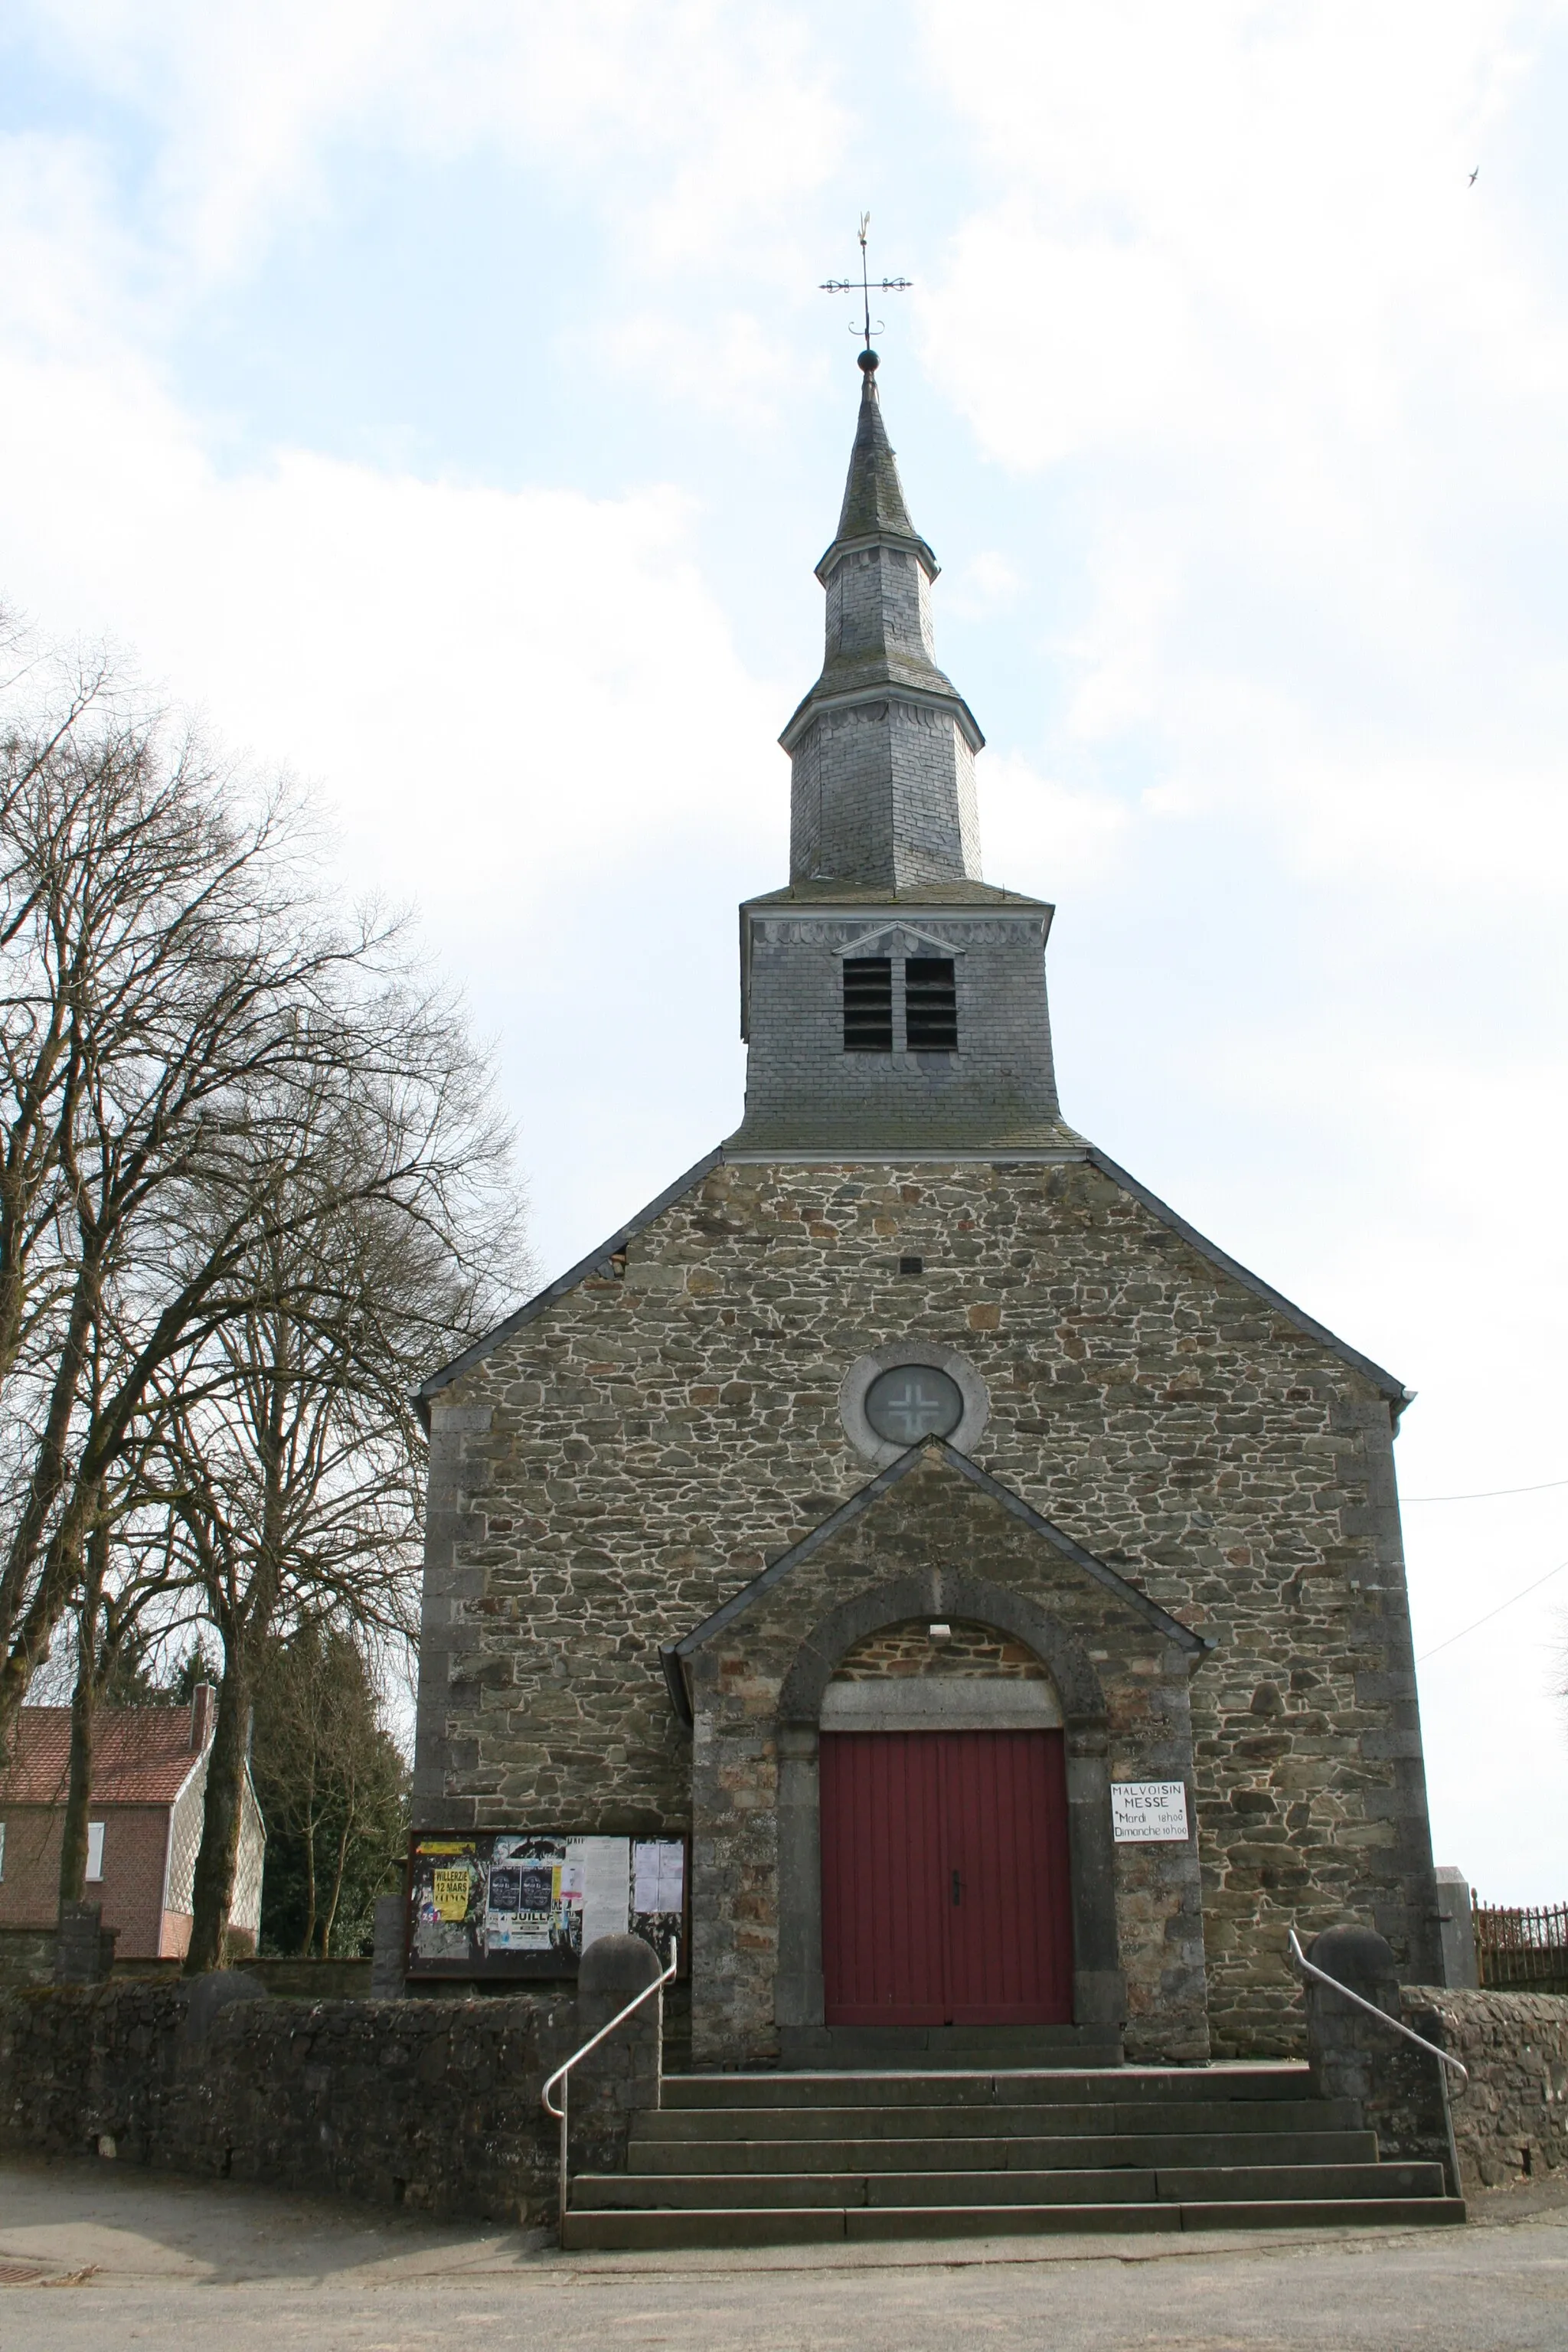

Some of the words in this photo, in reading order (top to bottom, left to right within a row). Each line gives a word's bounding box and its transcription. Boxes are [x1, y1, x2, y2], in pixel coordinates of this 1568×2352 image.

[1112, 1785, 1181, 1795] MALVOISIN
[1125, 1796, 1169, 1808] MESSE
[1119, 1812, 1146, 1823] Mardi
[1158, 1811, 1183, 1822] 18h00
[1115, 1825, 1160, 1837] Dimanche
[1163, 1824, 1187, 1834] 10h00
[436, 1883, 445, 1892] 12
[446, 1883, 467, 1892] MARS
